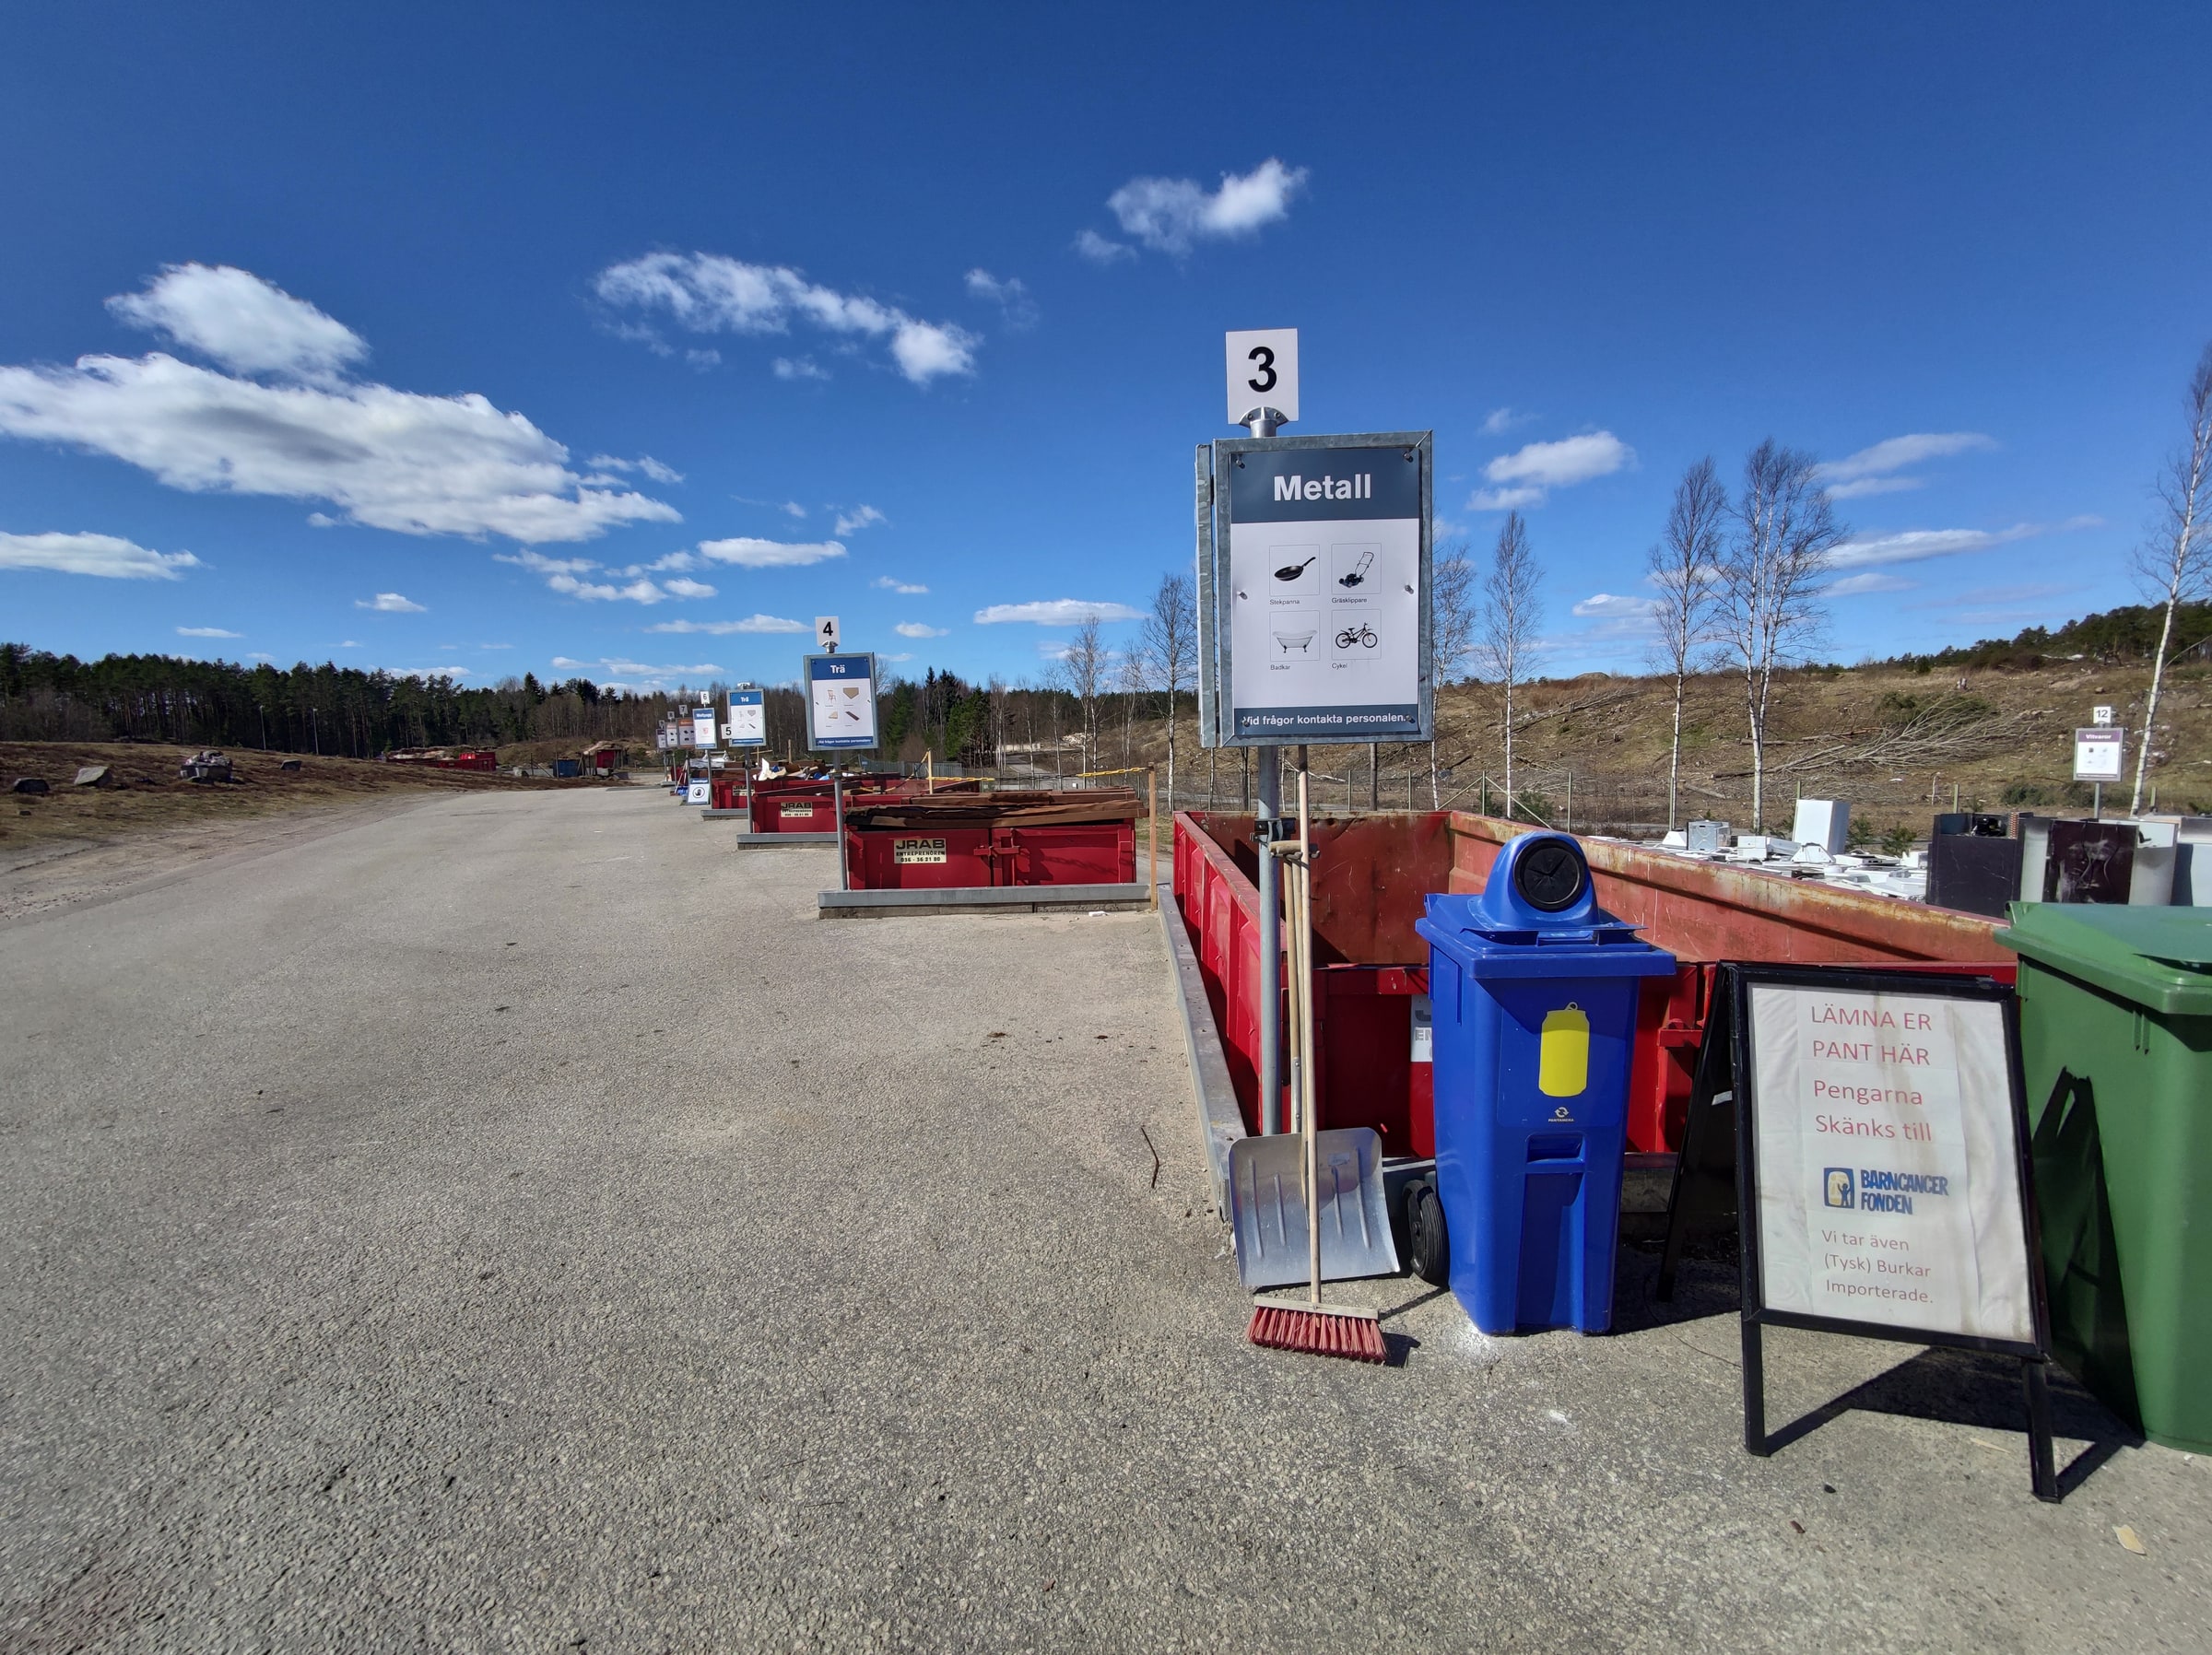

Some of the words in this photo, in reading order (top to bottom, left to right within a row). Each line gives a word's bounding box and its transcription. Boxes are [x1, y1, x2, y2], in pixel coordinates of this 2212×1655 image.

[1248, 346, 1277, 393] 3
[1274, 474, 1371, 501] Metall
[823, 621, 833, 636] 4
[830, 664, 846, 674] Trä
[1263, 714, 1294, 726] frågor
[1297, 714, 1343, 724] kontakta
[1346, 712, 1406, 724] personalen.
[2096, 710, 2108, 718] 12
[725, 727, 731, 735] 5
[895, 839, 945, 849] JRAB
[1811, 1003, 1896, 1028] LÄMNA
[1904, 1013, 1932, 1031] ER
[1813, 1040, 1873, 1061] PANT
[1881, 1042, 1930, 1065] HÄR
[1814, 1080, 1923, 1105] Pengarna
[1816, 1114, 1895, 1138] Skänks
[1902, 1122, 1931, 1141] till
[1860, 1169, 1948, 1195] BARNCANCER
[1860, 1191, 1912, 1215] FONDEN
[1821, 1229, 1837, 1243] Vi
[1842, 1232, 1864, 1246] tar
[1869, 1235, 1909, 1251] även
[1824, 1253, 1871, 1274] (Tysk)
[1877, 1260, 1931, 1277] Burkar
[1827, 1279, 1933, 1304] Importerade.
